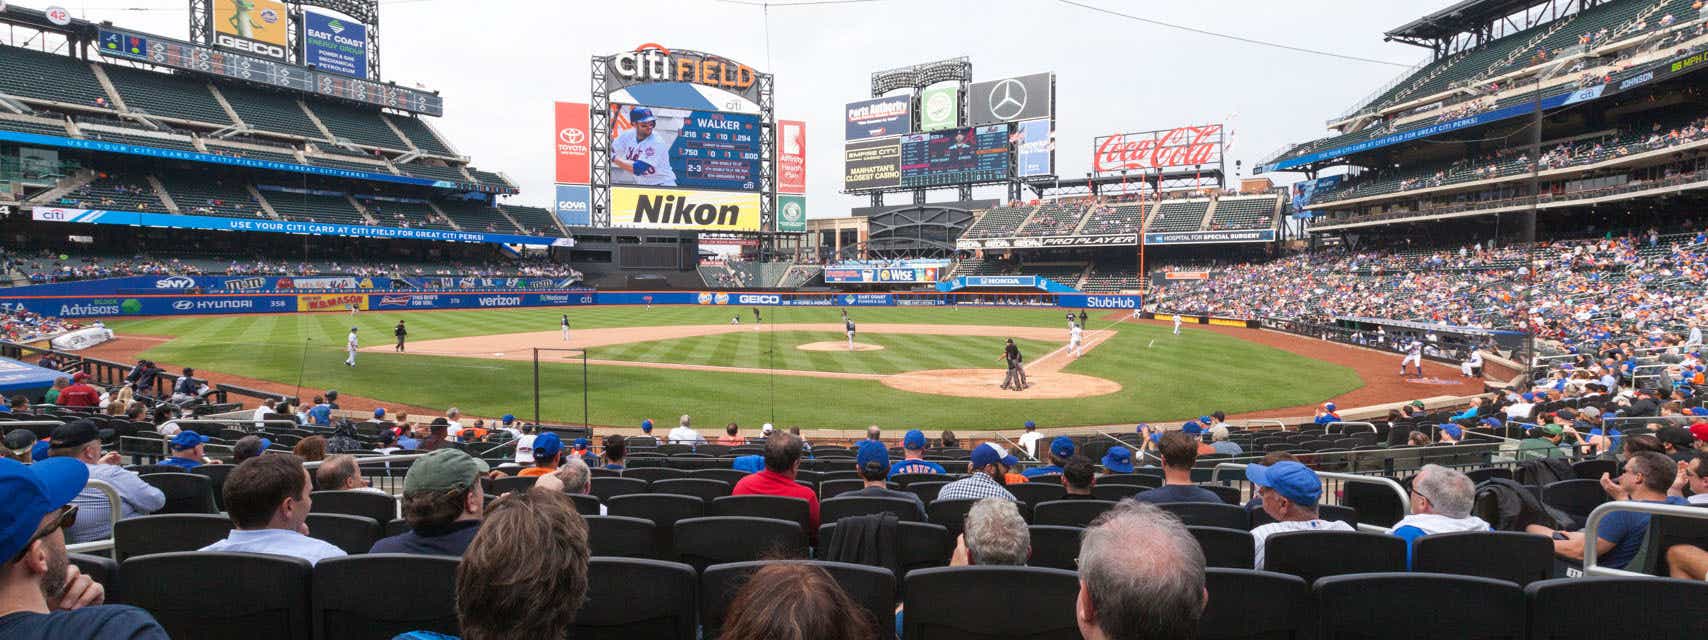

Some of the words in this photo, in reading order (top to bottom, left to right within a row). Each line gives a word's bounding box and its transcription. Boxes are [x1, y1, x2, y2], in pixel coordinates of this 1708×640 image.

[50, 10, 65, 20] 42
[308, 29, 331, 41] EAST
[334, 35, 364, 48] COAST
[218, 35, 283, 58] GEICO
[615, 42, 671, 80] citi
[677, 57, 755, 87] FIELD
[1621, 72, 1653, 89] JOHNSON
[1580, 89, 1594, 99] citi
[849, 106, 869, 118] Parts
[870, 101, 907, 115] Authority
[697, 118, 740, 130] WALKER
[1417, 127, 1437, 136] GREAT
[1439, 123, 1451, 132] CITI
[67, 140, 89, 148] USE
[97, 143, 125, 151] YOUR
[134, 147, 157, 155] CITI
[162, 150, 189, 158] CARD
[559, 144, 587, 152] TOYOTA
[848, 150, 878, 158] EMPIRE
[878, 147, 897, 155] CITY
[1094, 124, 1222, 172] Coca-Cola
[688, 164, 702, 172] 2-3
[850, 164, 895, 175] MANHATTAN'S
[846, 173, 874, 182] CLOSEST
[875, 170, 900, 180] CASINO
[743, 181, 755, 189] citi
[559, 201, 587, 209] GOYA
[633, 195, 740, 226] Nikon
[42, 209, 64, 220] citi
[230, 221, 251, 229] USE
[255, 222, 283, 231] YOUR
[286, 223, 306, 231] CITI
[309, 225, 334, 233] CARD
[351, 227, 369, 235] CITI
[371, 227, 395, 236] FIELD
[397, 229, 414, 237] FOR
[416, 230, 440, 239] GREAT
[442, 231, 457, 239] CITI
[459, 232, 484, 241] PERKS!
[1075, 236, 1135, 245] PLAYER
[890, 269, 913, 281] WISE
[156, 280, 188, 289] SNY
[197, 300, 253, 309] HYUNDAI
[479, 295, 520, 307] verizon
[580, 294, 592, 304] citi
[739, 295, 780, 304] GEICO
[1087, 297, 1135, 308] StubHub
[60, 303, 119, 316] Advisors
